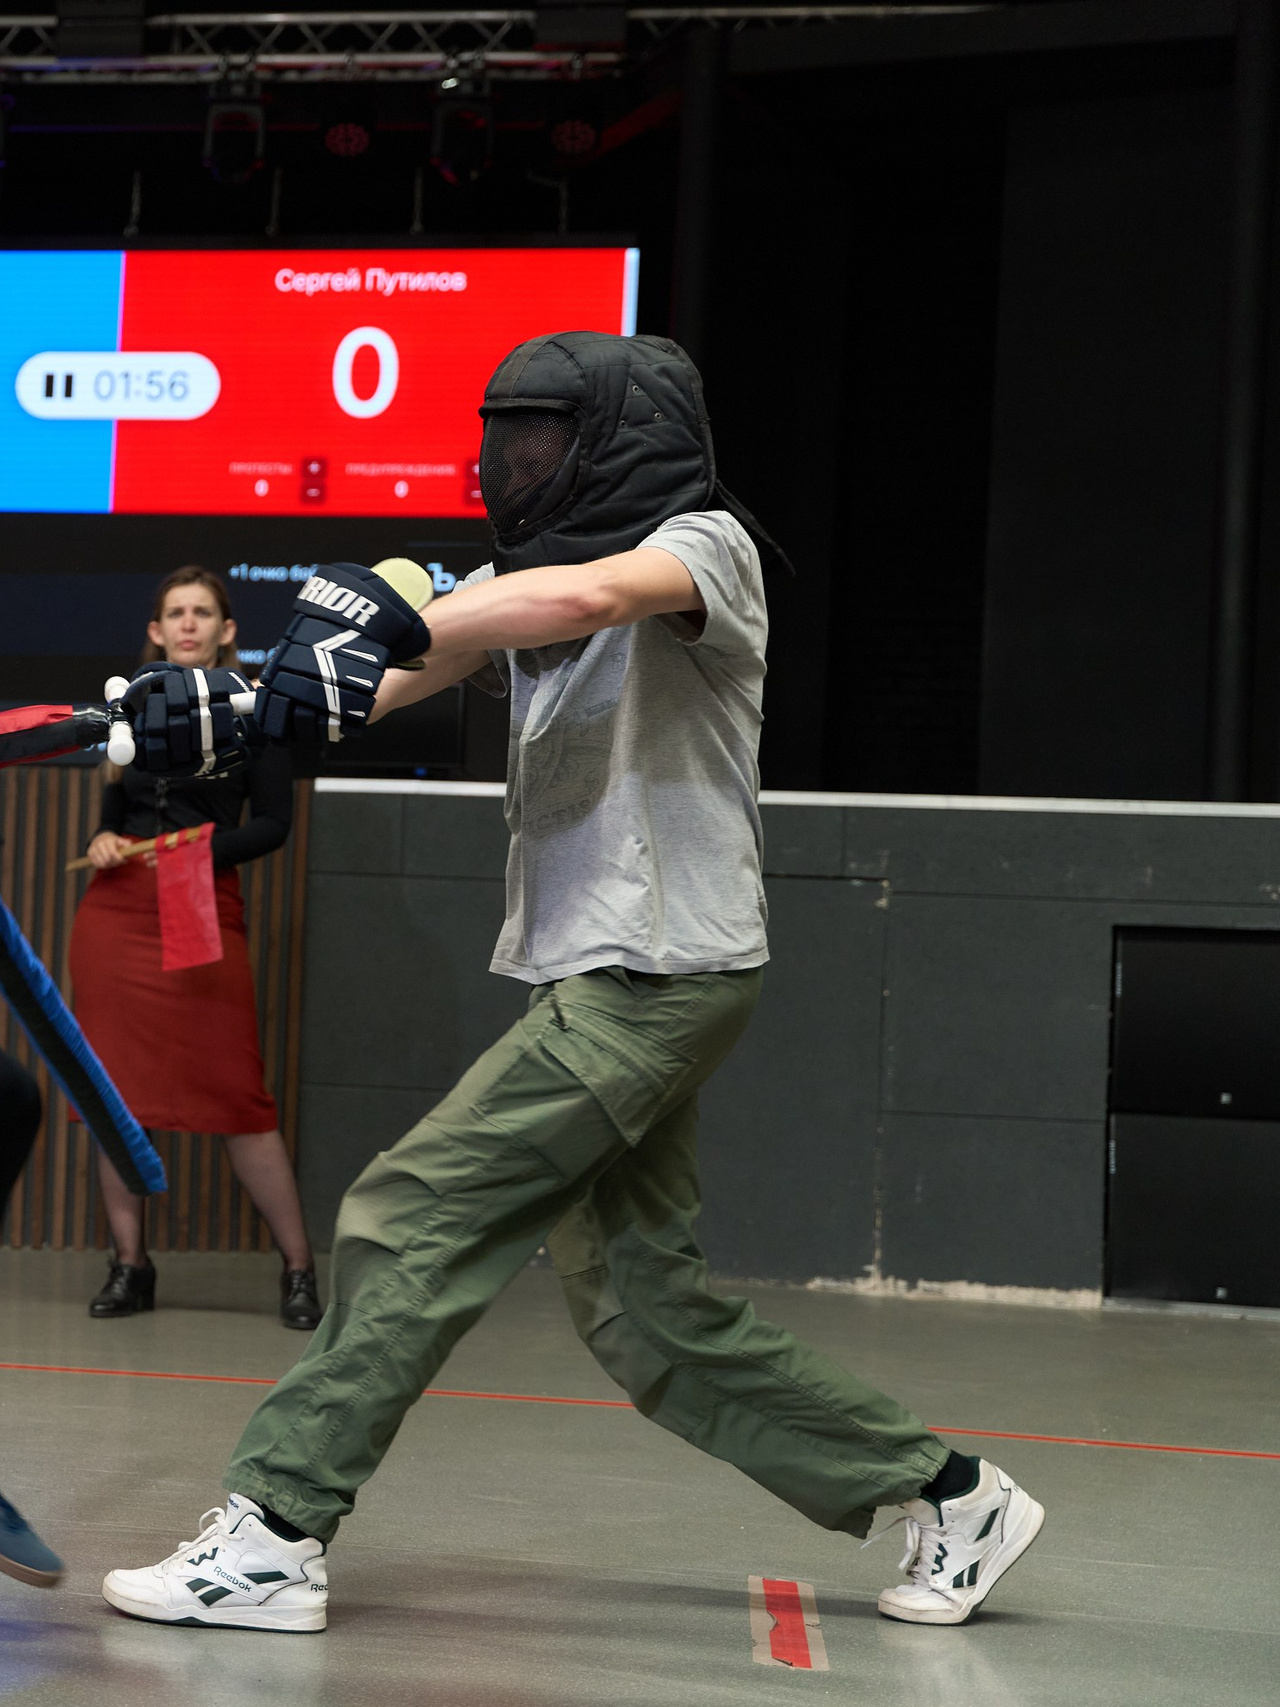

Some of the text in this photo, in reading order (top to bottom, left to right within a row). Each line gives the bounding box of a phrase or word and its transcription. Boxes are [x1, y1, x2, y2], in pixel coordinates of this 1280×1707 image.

[275, 267, 467, 296] Сергей Путилов
[93, 369, 191, 401] 01:56
[331, 326, 400, 419] 0
[213, 1565, 252, 1593] Reebok
